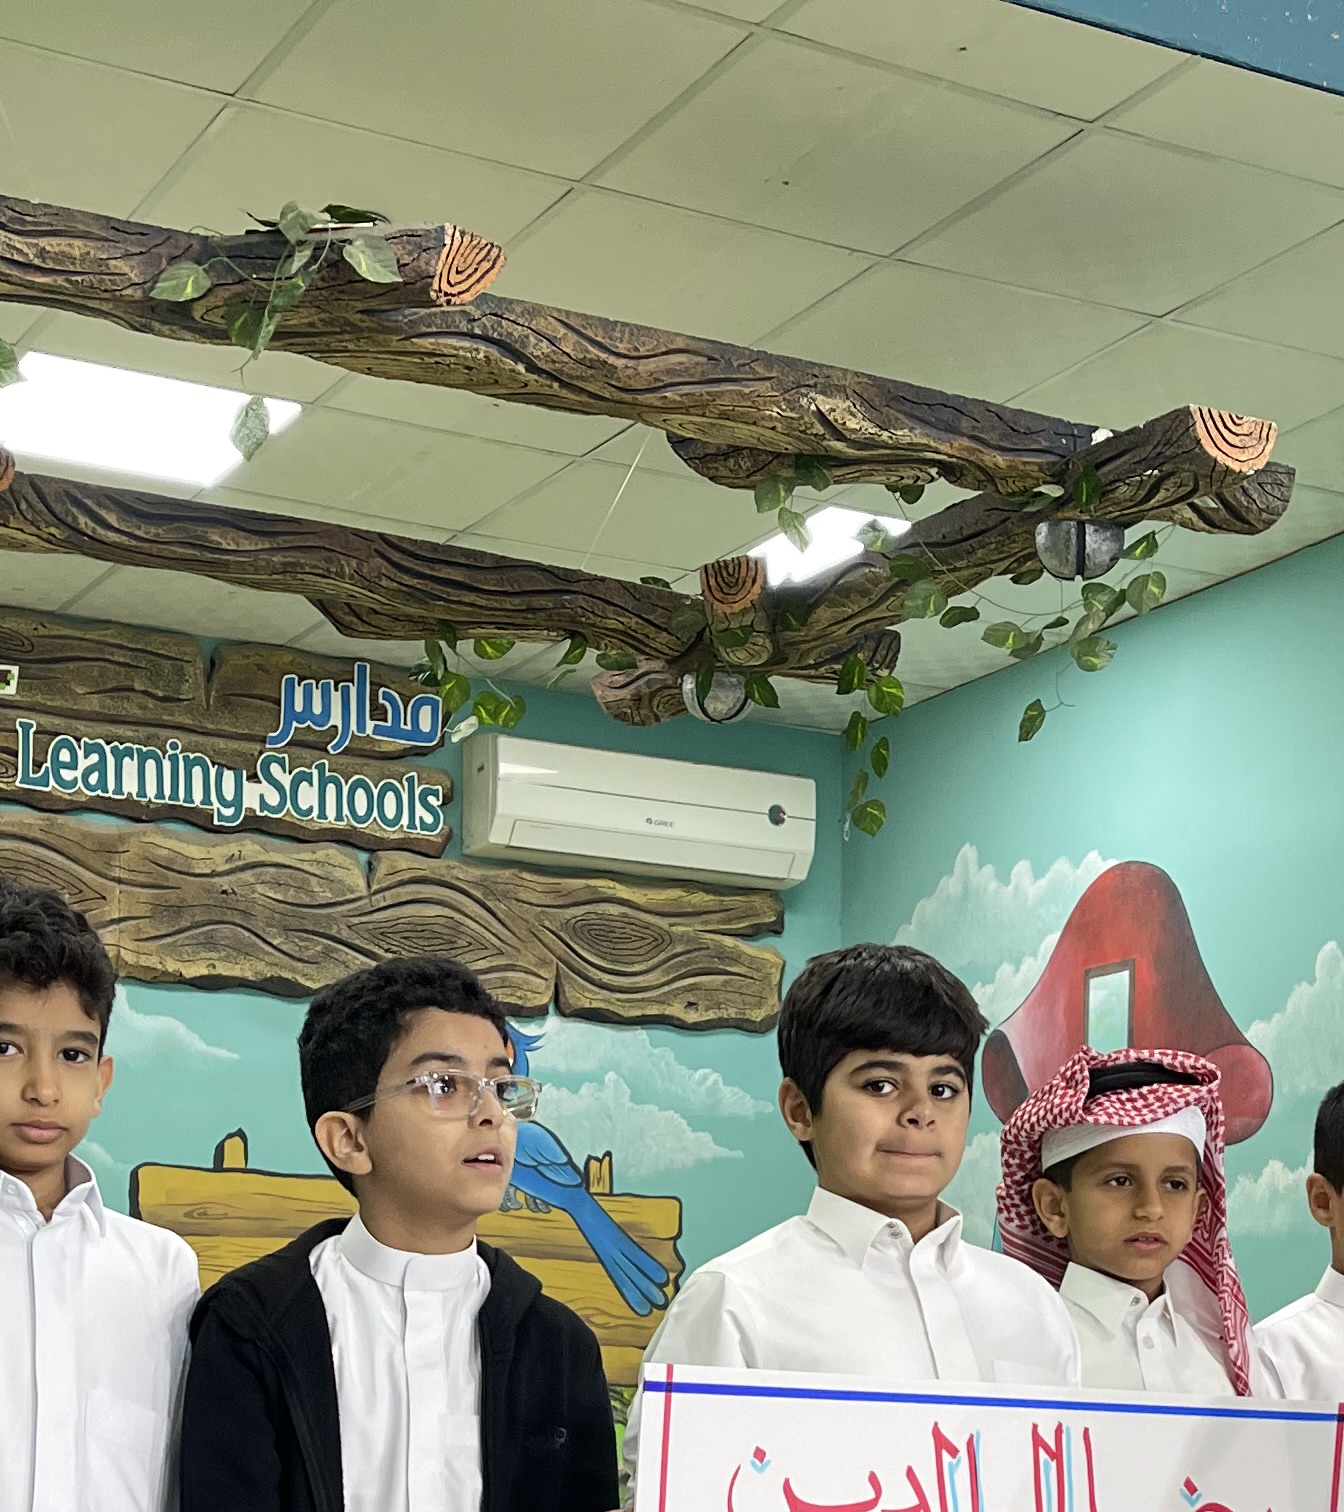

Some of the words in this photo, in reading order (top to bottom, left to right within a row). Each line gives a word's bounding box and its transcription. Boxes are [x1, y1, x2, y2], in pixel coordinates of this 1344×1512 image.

[265, 662, 445, 754] مدارس
[16, 718, 248, 827] Learning
[256, 751, 445, 836] Schools
